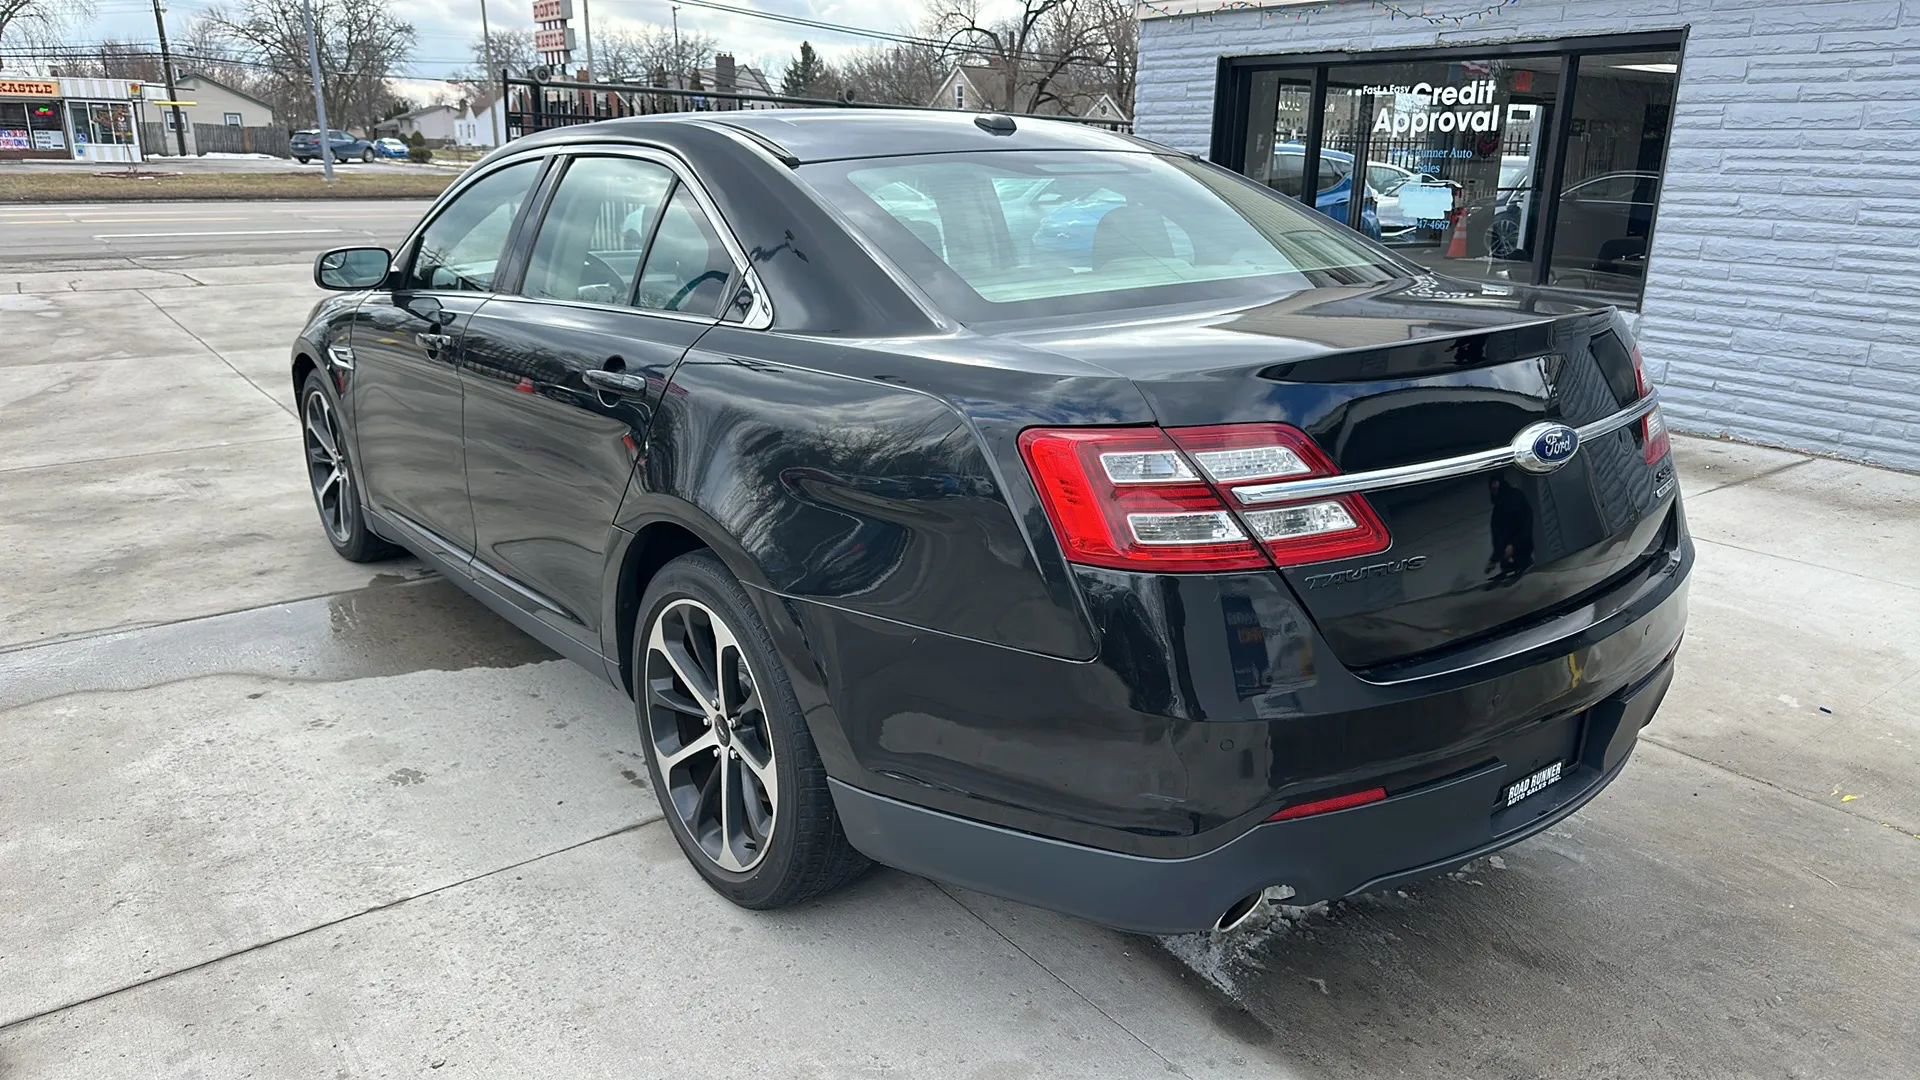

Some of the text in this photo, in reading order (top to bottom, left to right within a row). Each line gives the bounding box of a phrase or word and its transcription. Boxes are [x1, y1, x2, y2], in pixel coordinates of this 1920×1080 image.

[0, 83, 53, 94] KASTLE
[1362, 85, 1381, 95] Fast
[1389, 84, 1411, 95] Easy
[1411, 80, 1496, 106] Credit
[1372, 104, 1500, 138] Approval
[1449, 147, 1473, 159] Auto
[1418, 162, 1441, 173] Sales
[1545, 432, 1571, 457] Ford
[1304, 556, 1427, 589] TAURUS
[1507, 774, 1562, 807] AUTO SALES INC.
[1508, 762, 1562, 800] ROAD RUNNER
